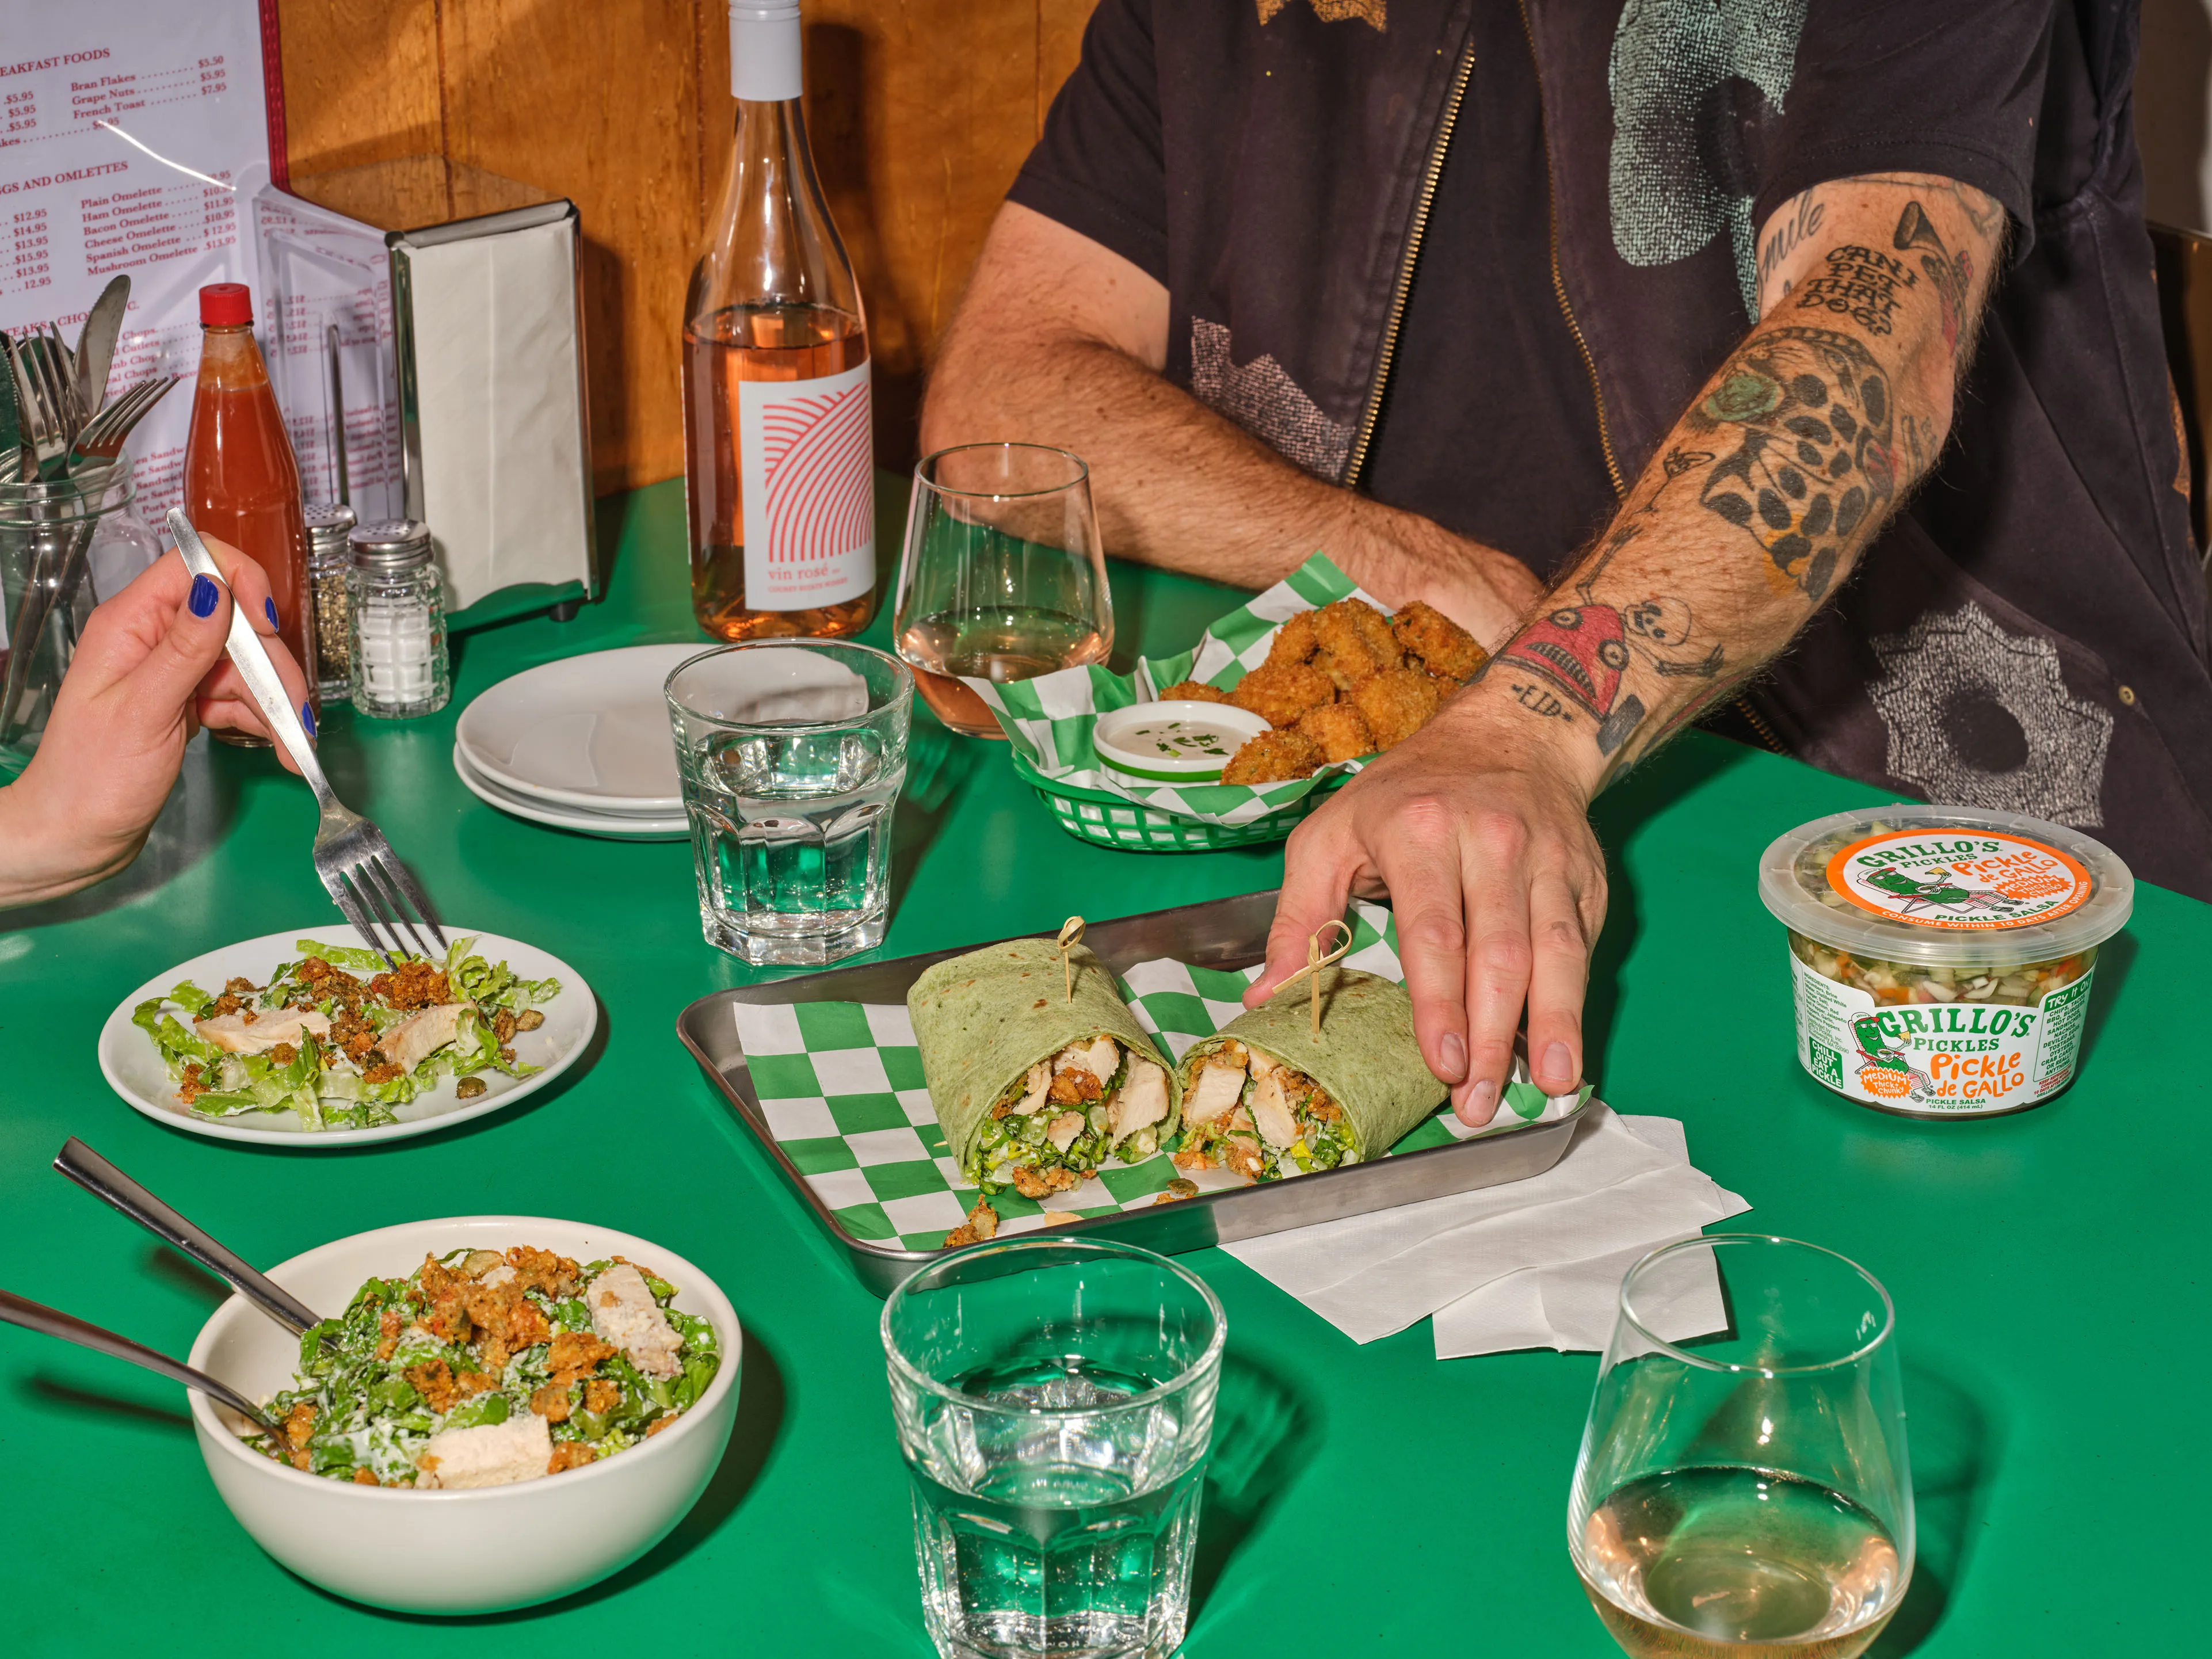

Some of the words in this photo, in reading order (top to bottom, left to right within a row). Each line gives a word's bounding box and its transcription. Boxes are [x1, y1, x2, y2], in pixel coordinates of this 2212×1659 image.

[63, 48, 110, 64] FOODS
[71, 81, 98, 92] Bran
[100, 74, 136, 86] Flakes
[198, 55, 224, 68] $5.50
[72, 94, 106, 105] Grape
[109, 88, 135, 98] Nuts
[200, 68, 226, 82] $5.95
[6, 91, 34, 104] $5.95
[73, 104, 112, 119] French
[114, 100, 146, 112] Toast
[201, 82, 227, 96] $7.95
[8, 104, 36, 118] $5.95
[9, 118, 37, 132] $5.95
[0, 138, 21, 148] kes
[0, 182, 19, 195] GS
[23, 176, 51, 190] AND
[55, 161, 128, 184] OMLETTES
[81, 197, 109, 209] Plain
[112, 187, 162, 203] Omelette
[14, 208, 47, 223] $12.95
[82, 211, 109, 223] Ham
[112, 201, 162, 216] Omelette
[83, 224, 116, 236] Bacon
[119, 213, 169, 228] Omelette
[204, 196, 234, 211] $11.95
[14, 222, 47, 237] $14.95
[85, 236, 123, 249] Cheese
[127, 225, 176, 241] Omelette
[205, 209, 235, 224] $10.95
[15, 236, 48, 251] $13.95
[86, 246, 129, 264] Spanish
[132, 237, 181, 253] Omelette
[16, 250, 48, 265] $15.95
[87, 258, 147, 276] Mushroom
[149, 247, 198, 262] Omelette
[206, 235, 236, 250] $13.95
[16, 263, 49, 278] $13.95
[1825, 245, 1903, 280] CAN
[1902, 268, 1920, 290] I
[25, 277, 51, 289] 12.95
[1828, 262, 1902, 296] PET
[1807, 279, 1902, 319] THAT
[58, 311, 91, 326] CHO
[122, 327, 156, 341] Chops
[122, 340, 159, 353] Cutlets
[130, 354, 163, 365] Chop
[124, 367, 158, 380] Chops
[142, 501, 166, 514] Pork
[768, 567, 792, 581] vin
[797, 562, 828, 579] rosé
[1856, 841, 2000, 867] GRILLO'S
[1900, 853, 1978, 868] PICKLES
[1979, 874, 1999, 883] de
[1999, 859, 2058, 878] GALLO
[2030, 883, 2062, 896] Chunky
[1882, 911, 1942, 926] CONSUME
[2017, 915, 2046, 924] DAYS
[2048, 903, 2073, 917] AFTER
[2069, 881, 2088, 904] OPENING
[1935, 914, 2007, 922] PICKLE
[2009, 900, 2060, 918] SALSA
[1826, 990, 1837, 999] Brine
[2048, 993, 2068, 1008] TRY
[1833, 998, 1847, 1008] White
[2050, 1005, 2069, 1017] CHIPS,
[1876, 1008, 2036, 1038] GRILLO'S
[2047, 1015, 2062, 1024] BBQ,
[2053, 1017, 2066, 1027] HOT
[1913, 1038, 2000, 1052] PICKLES
[2043, 1033, 2068, 1048] DEVILED
[1812, 1040, 1837, 1061] CHILL
[1816, 1051, 1833, 1066] OUT
[2041, 1056, 2057, 1066] CRAB
[1814, 1057, 1829, 1072] EAT
[1831, 1068, 1838, 1078] A
[1812, 1063, 1842, 1088] PICKLE
[1878, 1086, 1904, 1094] Chunky
[1936, 1080, 1957, 1097] de
[1963, 1073, 2024, 1099] GALLO
